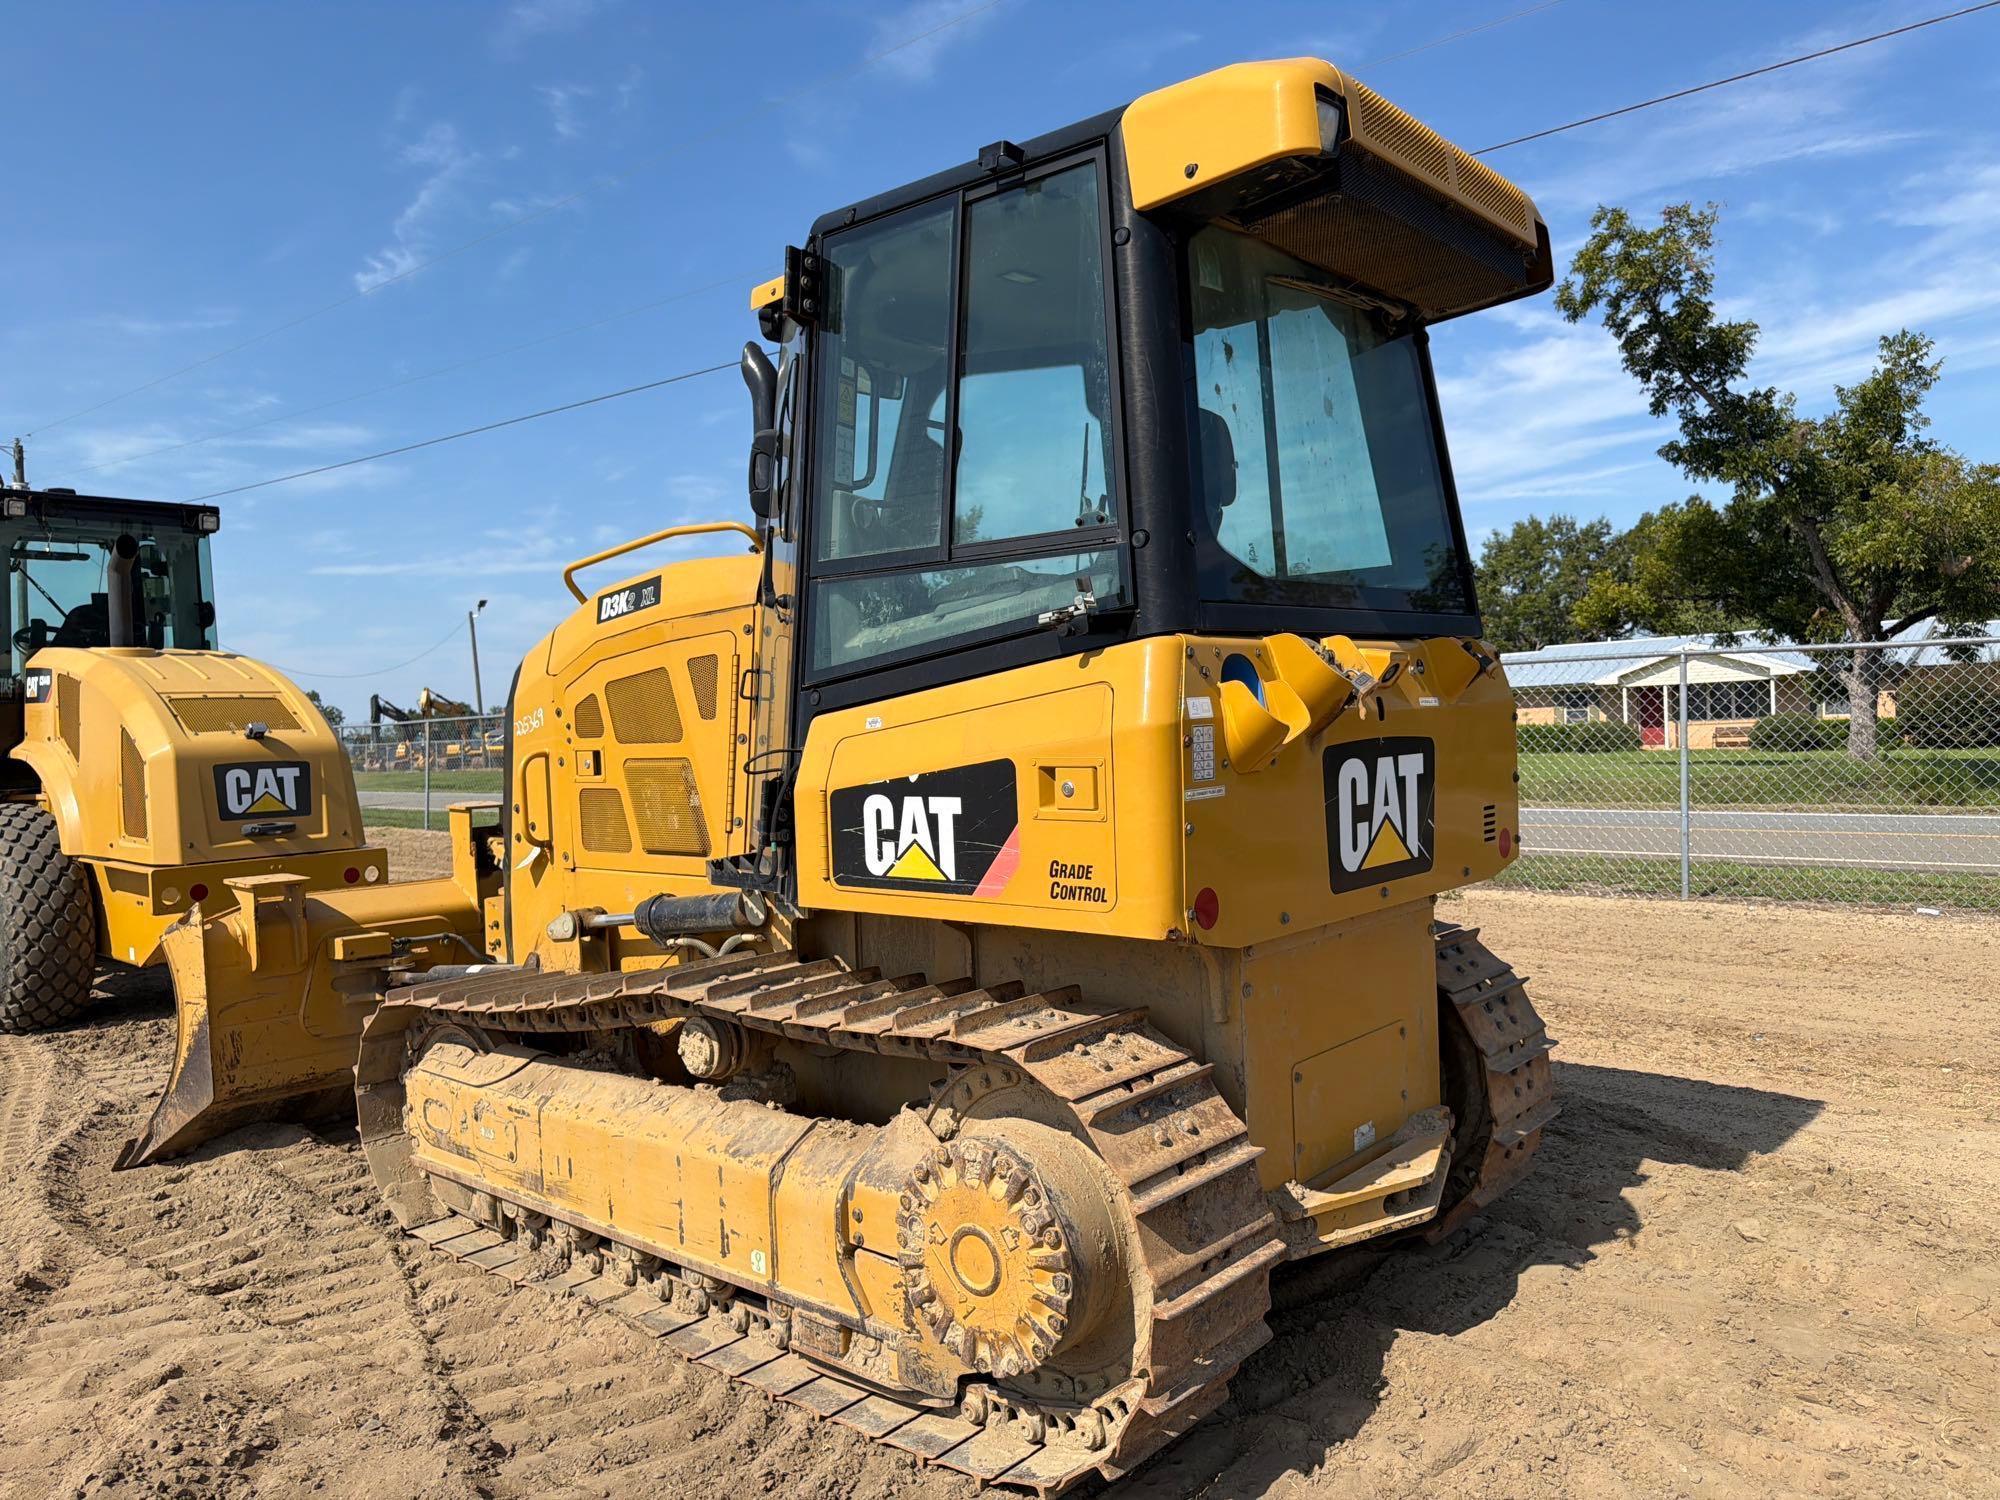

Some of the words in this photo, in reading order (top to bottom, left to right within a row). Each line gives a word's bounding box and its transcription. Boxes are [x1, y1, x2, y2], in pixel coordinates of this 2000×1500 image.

[27, 676, 39, 698] CAT
[225, 767, 300, 814] CAT
[1338, 753, 1424, 873] CAT
[863, 794, 962, 881] CAT
